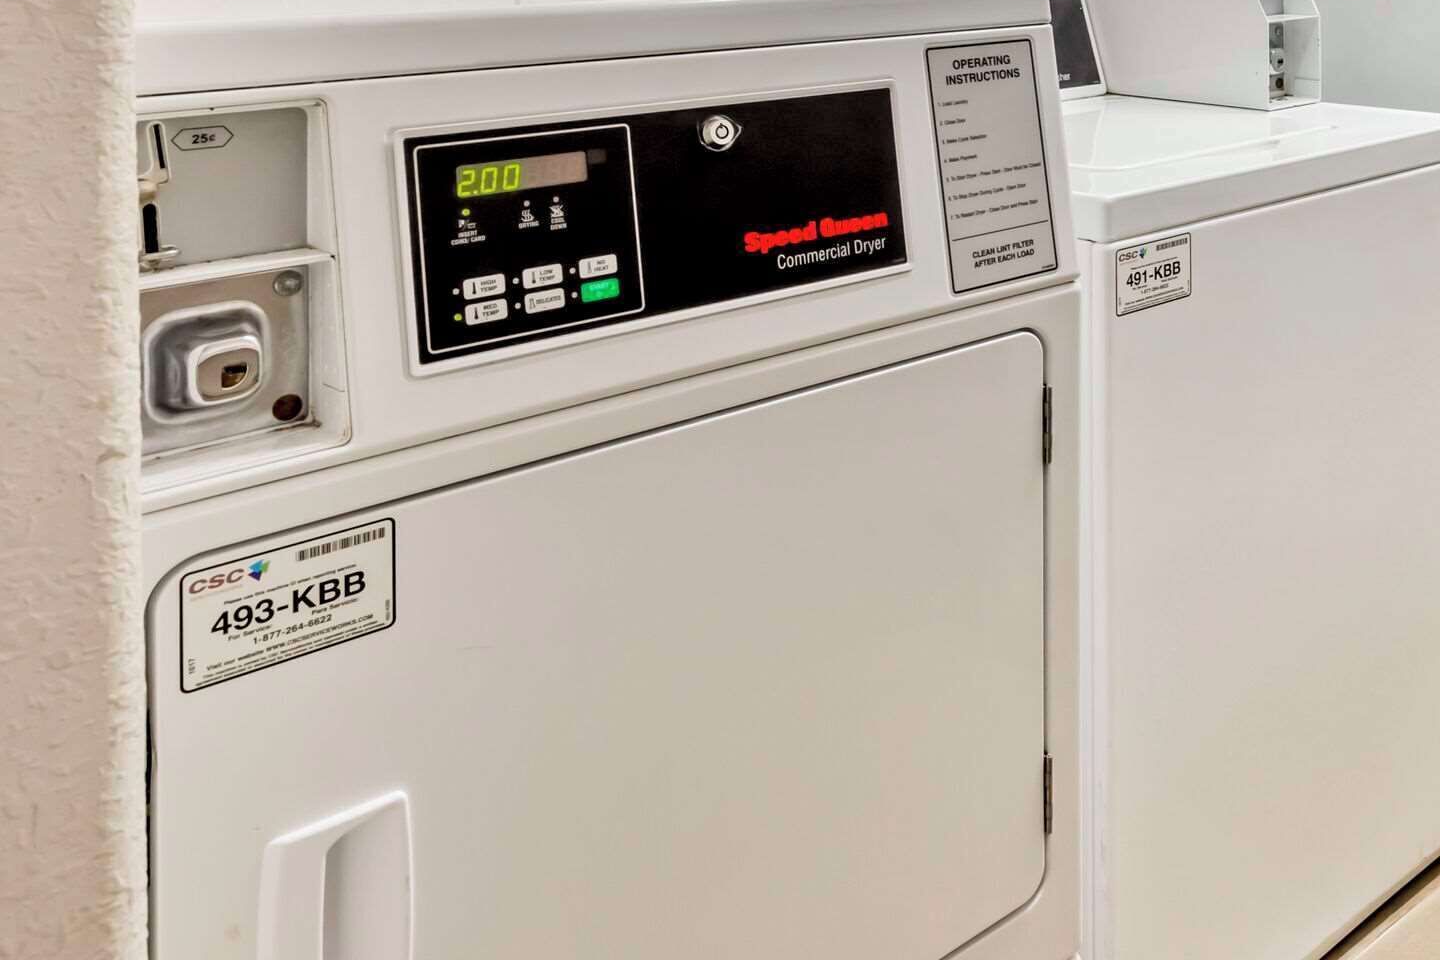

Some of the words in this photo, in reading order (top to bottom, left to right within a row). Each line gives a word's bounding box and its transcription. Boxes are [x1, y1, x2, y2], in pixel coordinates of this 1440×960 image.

[952, 54, 1011, 70] OPERATING
[945, 68, 1021, 86] INSTRUCTIONS
[456, 164, 521, 198] 2.00
[744, 221, 817, 254] Speed
[820, 212, 889, 238] Queen
[777, 242, 850, 270] Commercial
[854, 237, 886, 254] Dryer
[972, 246, 996, 259] CLEAN
[996, 244, 1011, 254] LINT
[1012, 240, 1034, 250] FILTER
[974, 257, 997, 268] AFTER
[998, 253, 1015, 264] EACH
[1017, 249, 1034, 259] LOAD
[1119, 251, 1138, 262] CSC
[1126, 261, 1180, 287] 491-KBB
[188, 568, 245, 594] CSC
[211, 570, 366, 636] 493-KBB
[253, 614, 332, 645] 1-877-264-6622
